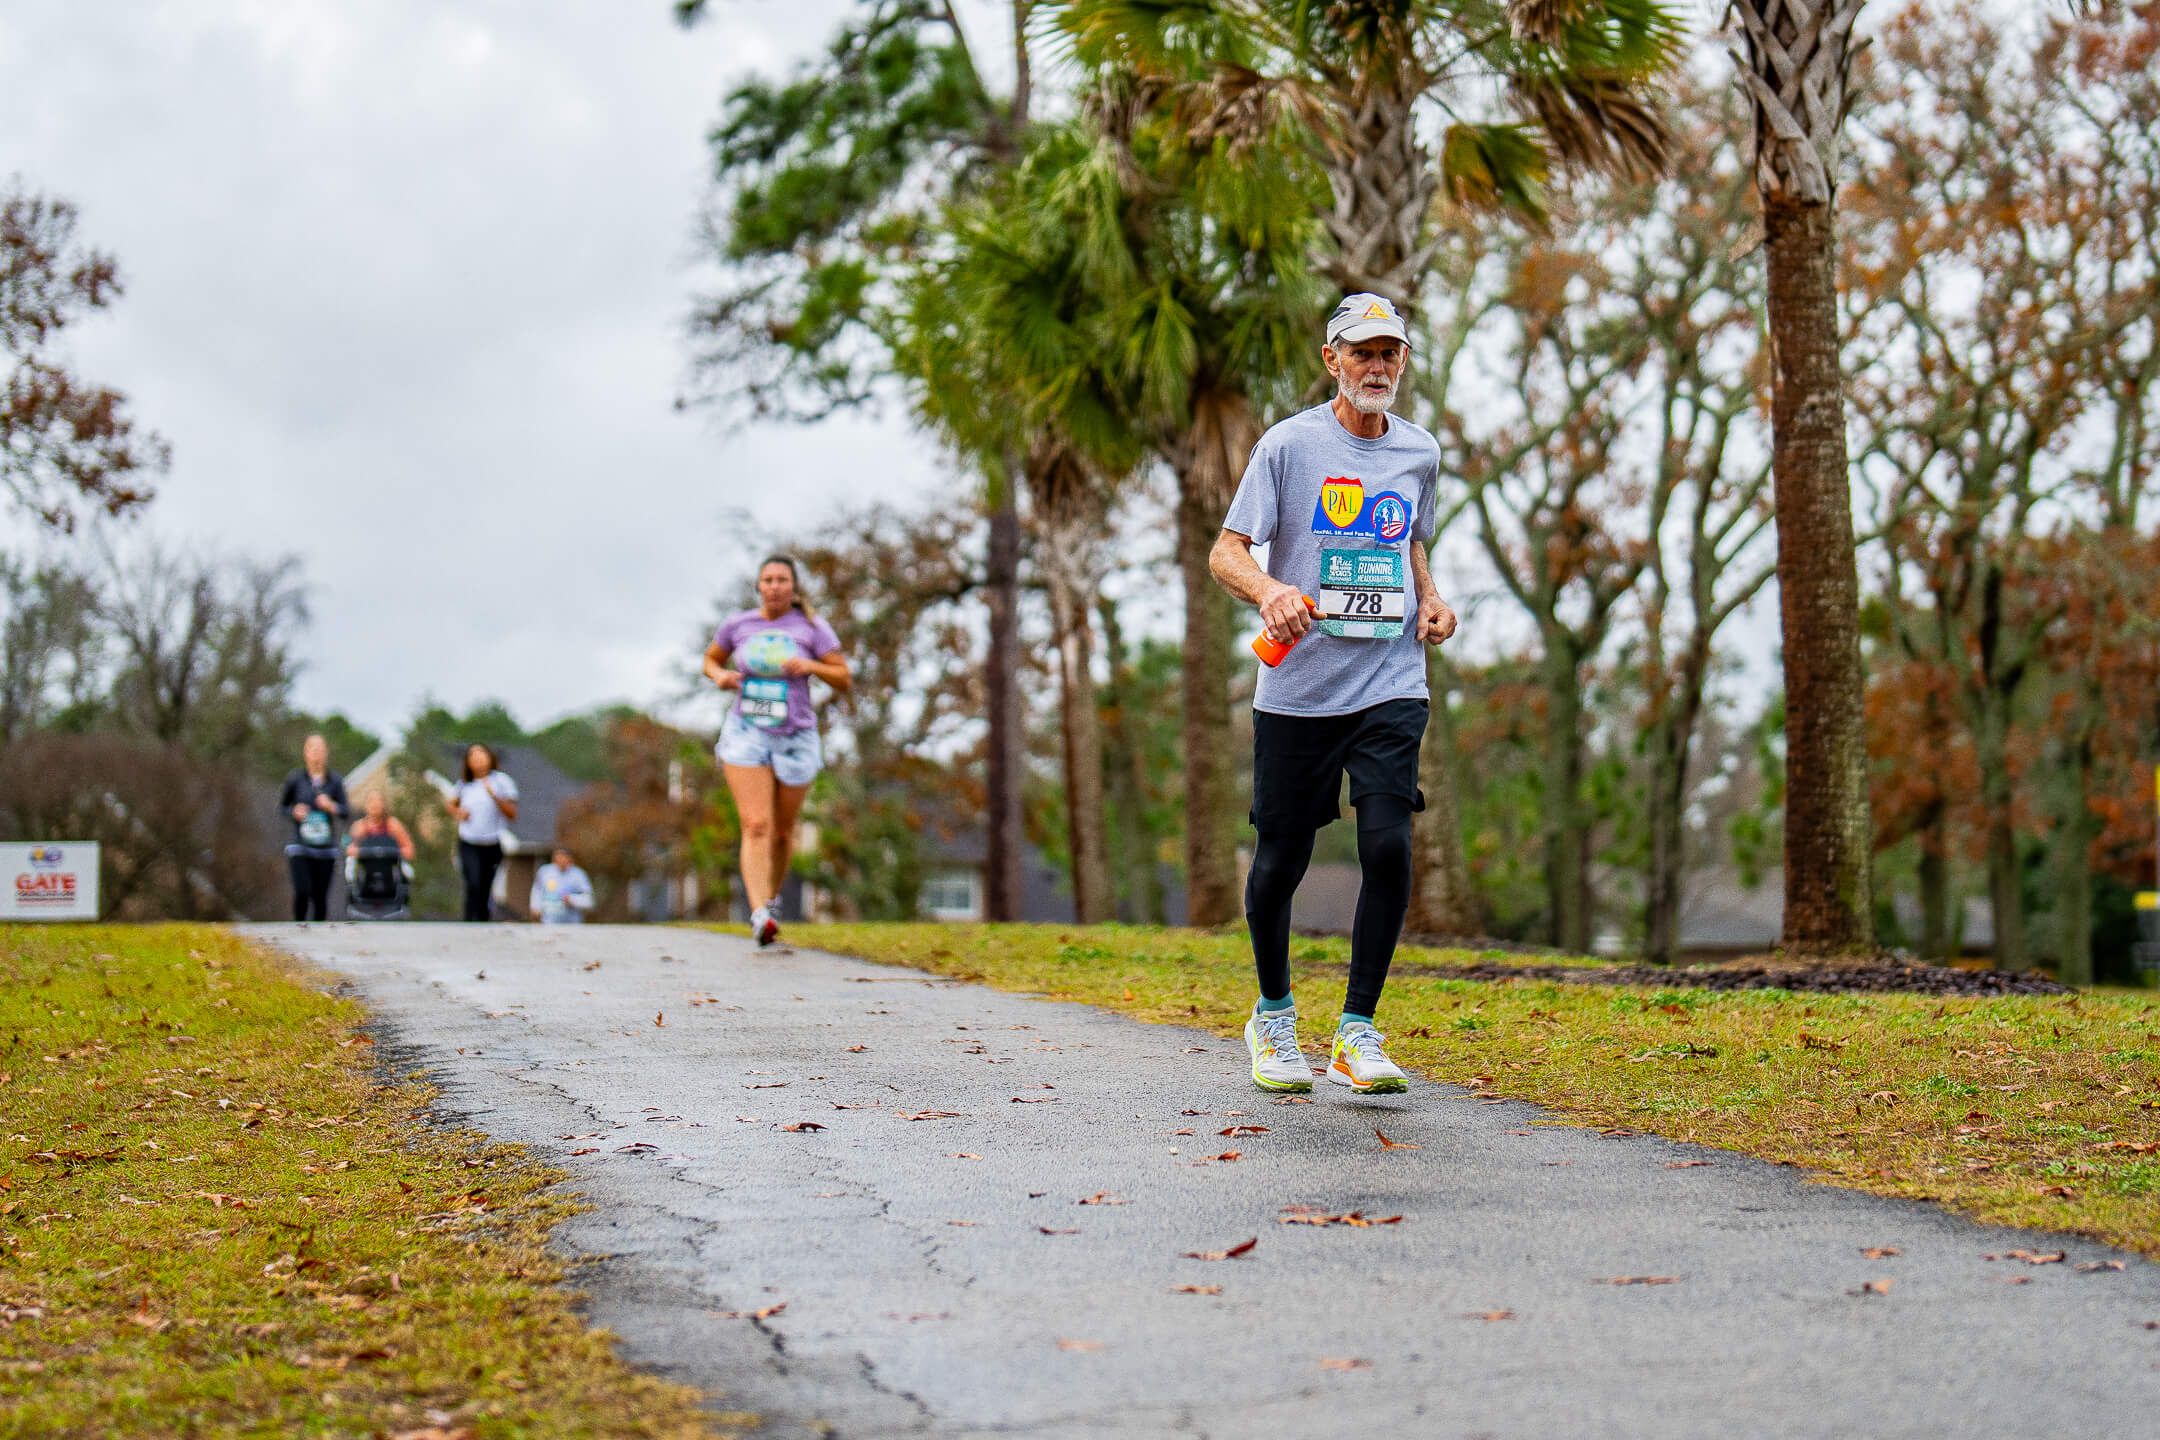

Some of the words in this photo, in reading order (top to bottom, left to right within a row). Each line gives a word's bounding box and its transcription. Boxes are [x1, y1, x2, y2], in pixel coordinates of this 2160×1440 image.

[1328, 489, 1357, 514] PAL
[1357, 562, 1393, 575] RUNNING
[1343, 592, 1382, 614] 728
[16, 872, 76, 890] GATE
